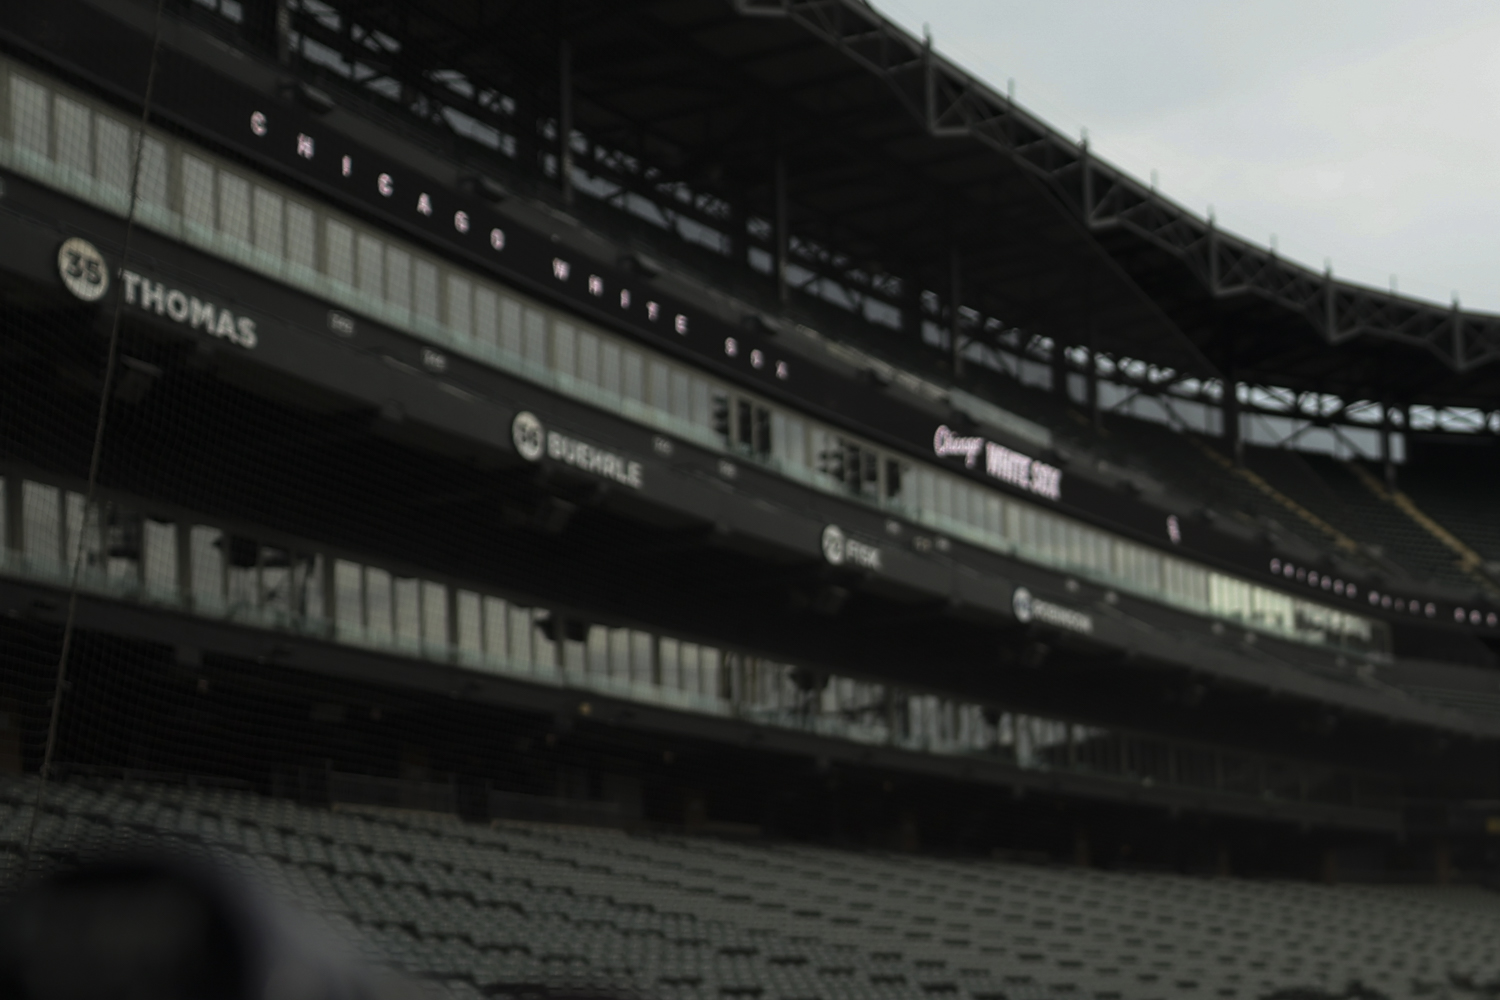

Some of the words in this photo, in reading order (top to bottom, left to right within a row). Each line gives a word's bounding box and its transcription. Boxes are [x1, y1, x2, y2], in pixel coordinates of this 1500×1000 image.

[250, 110, 507, 252] CHICAGO
[552, 257, 689, 337] WHITE
[118, 267, 258, 349] THOMAS
[546, 430, 643, 490] BUEHRLE
